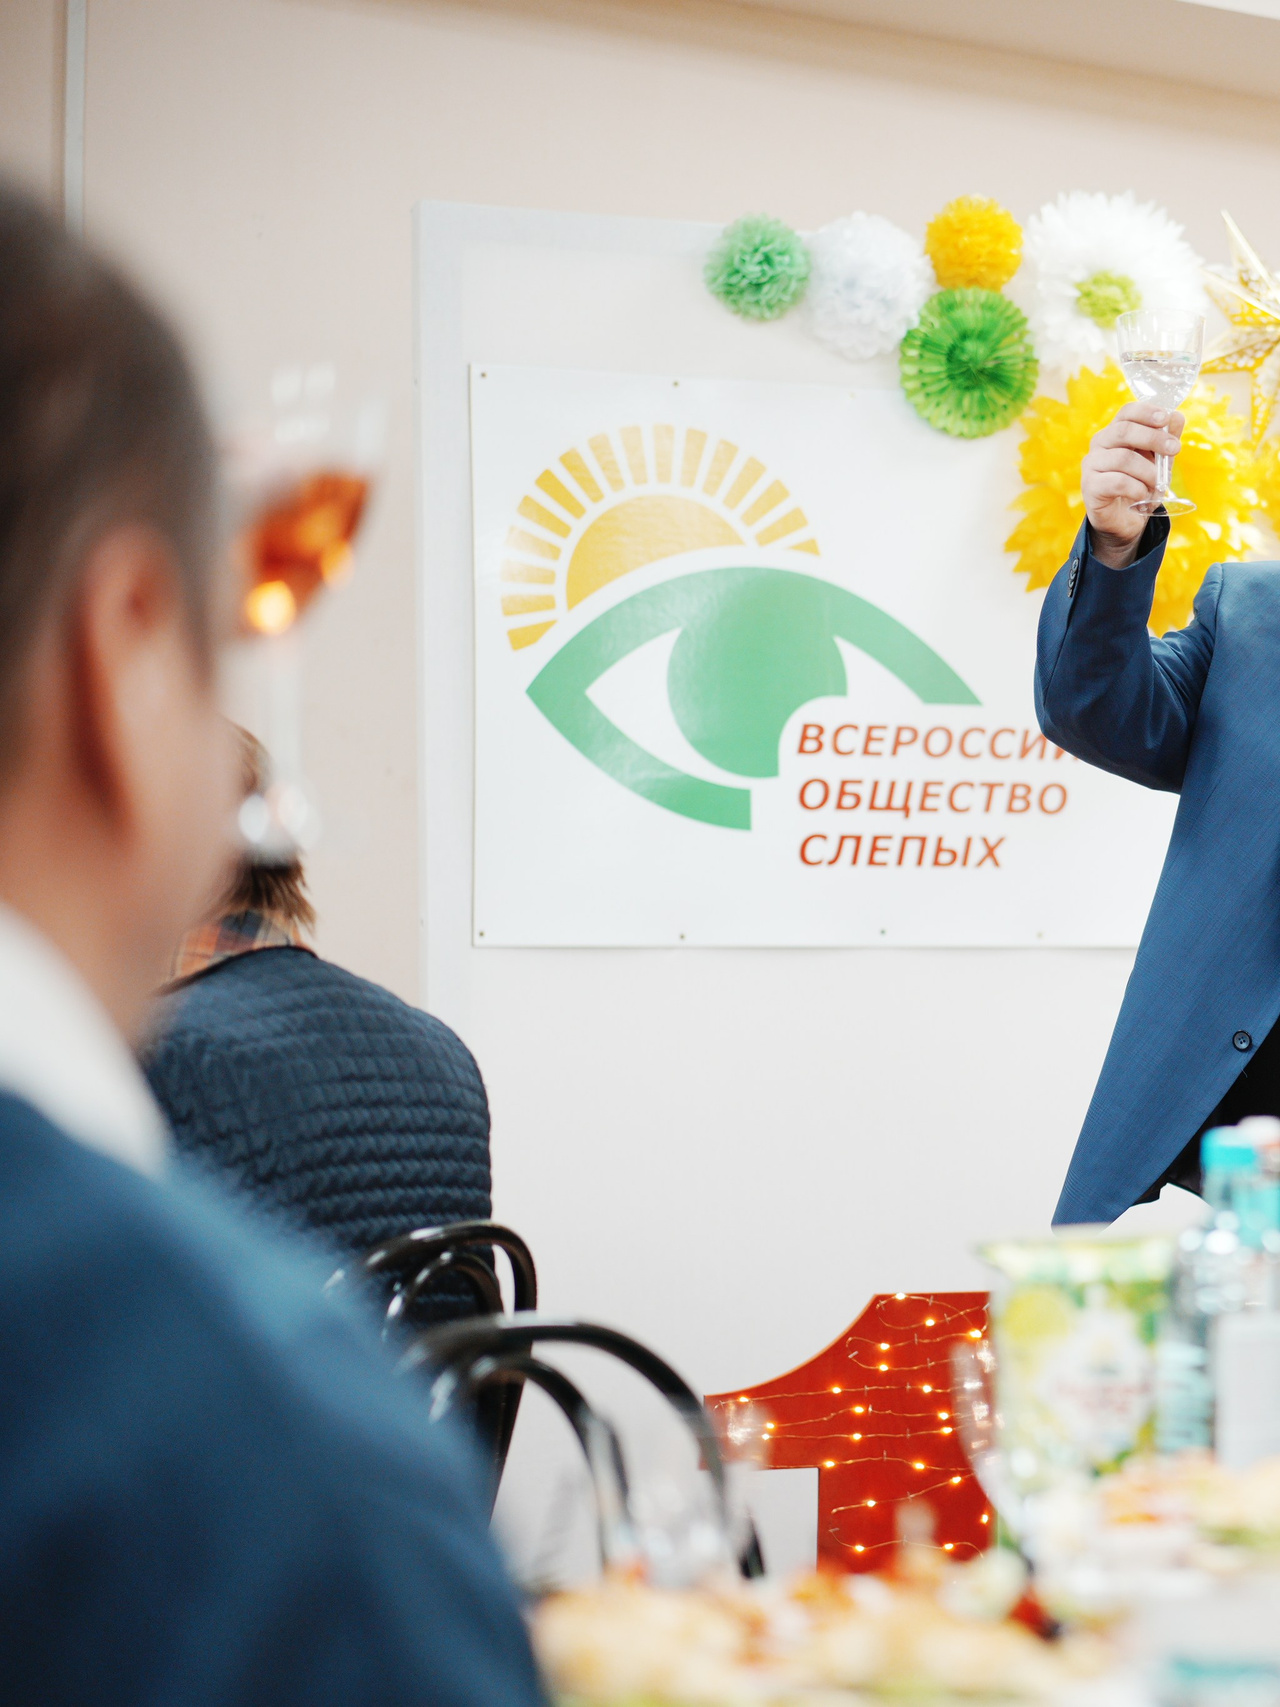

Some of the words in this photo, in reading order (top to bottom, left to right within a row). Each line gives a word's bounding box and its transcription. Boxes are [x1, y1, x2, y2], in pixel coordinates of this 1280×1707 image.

[797, 723, 1079, 761] ВСЕРОССИ
[798, 777, 1068, 819] ОБЩЕСТВО
[799, 833, 1007, 868] СЛЕПЫХ
